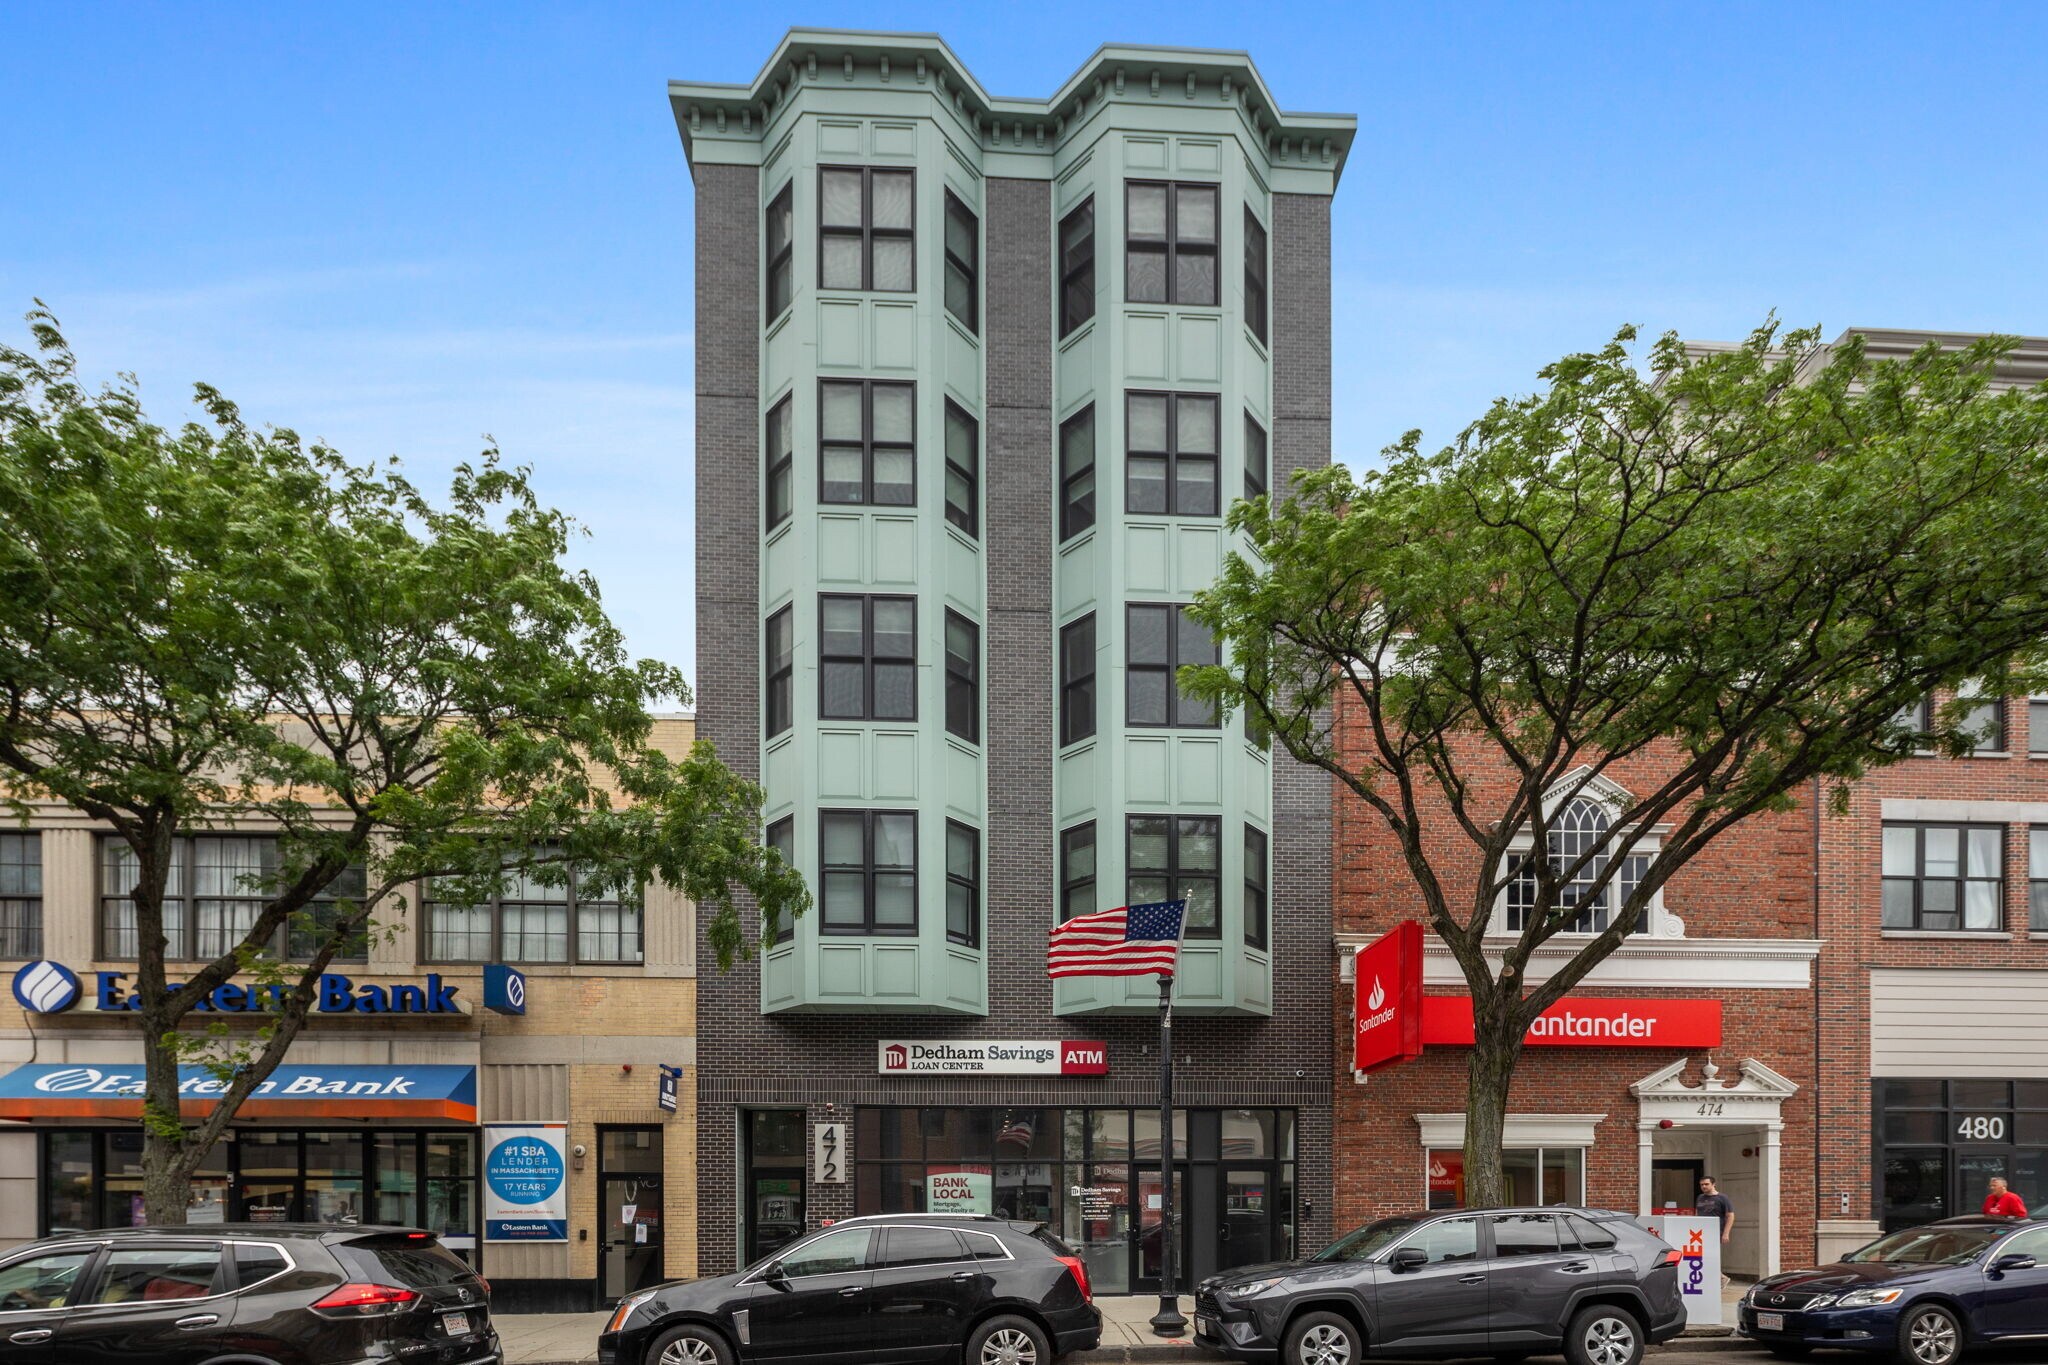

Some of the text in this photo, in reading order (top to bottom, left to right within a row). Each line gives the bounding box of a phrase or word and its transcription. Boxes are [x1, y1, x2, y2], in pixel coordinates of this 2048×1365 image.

[318, 973, 459, 1013] Bank
[1360, 1007, 1395, 1034] Santander
[1526, 1011, 1656, 1037] antander
[911, 1045, 1054, 1063] Dedham Savings
[1065, 1050, 1102, 1064] ATM
[912, 1062, 984, 1070] LOAN CENTER
[281, 1076, 414, 1095] Bank
[1697, 1103, 1723, 1116] 474
[1957, 1117, 2004, 1139] 480
[504, 1146, 546, 1156] #1 SBA
[822, 1126, 837, 1181] 472
[501, 1158, 549, 1166] LENDER
[504, 1183, 546, 1191] 17 YEARS
[933, 1177, 968, 1188] BANK
[933, 1189, 974, 1199] LOCAL
[1682, 1229, 1703, 1295] FedEx
